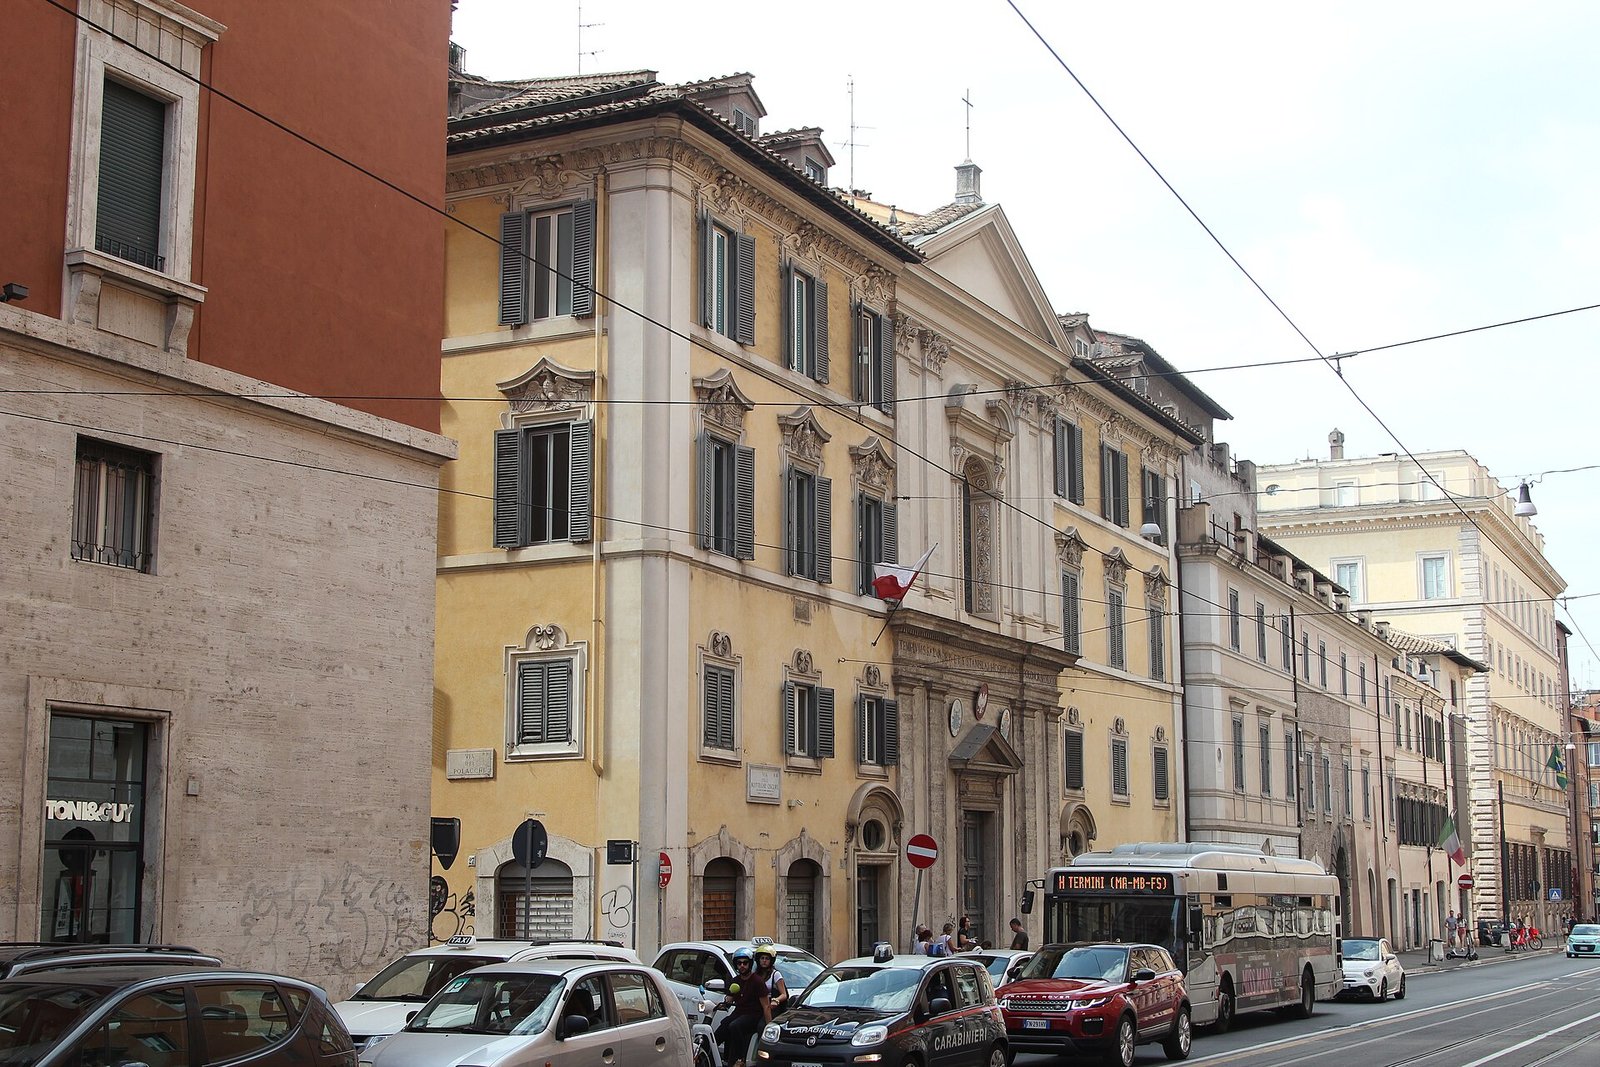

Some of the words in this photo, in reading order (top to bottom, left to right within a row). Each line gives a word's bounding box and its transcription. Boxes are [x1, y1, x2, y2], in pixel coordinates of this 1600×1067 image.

[45, 799, 135, 823] TONI&GUY
[1058, 875, 1065, 890] H
[1068, 875, 1105, 890] TERMINI
[1110, 876, 1167, 890] (MA-MB-FS)
[451, 936, 471, 944] TAXI
[755, 937, 773, 945] TAXI
[790, 1026, 847, 1036] CARABINIERI
[934, 1027, 988, 1051] CARABINIERI
